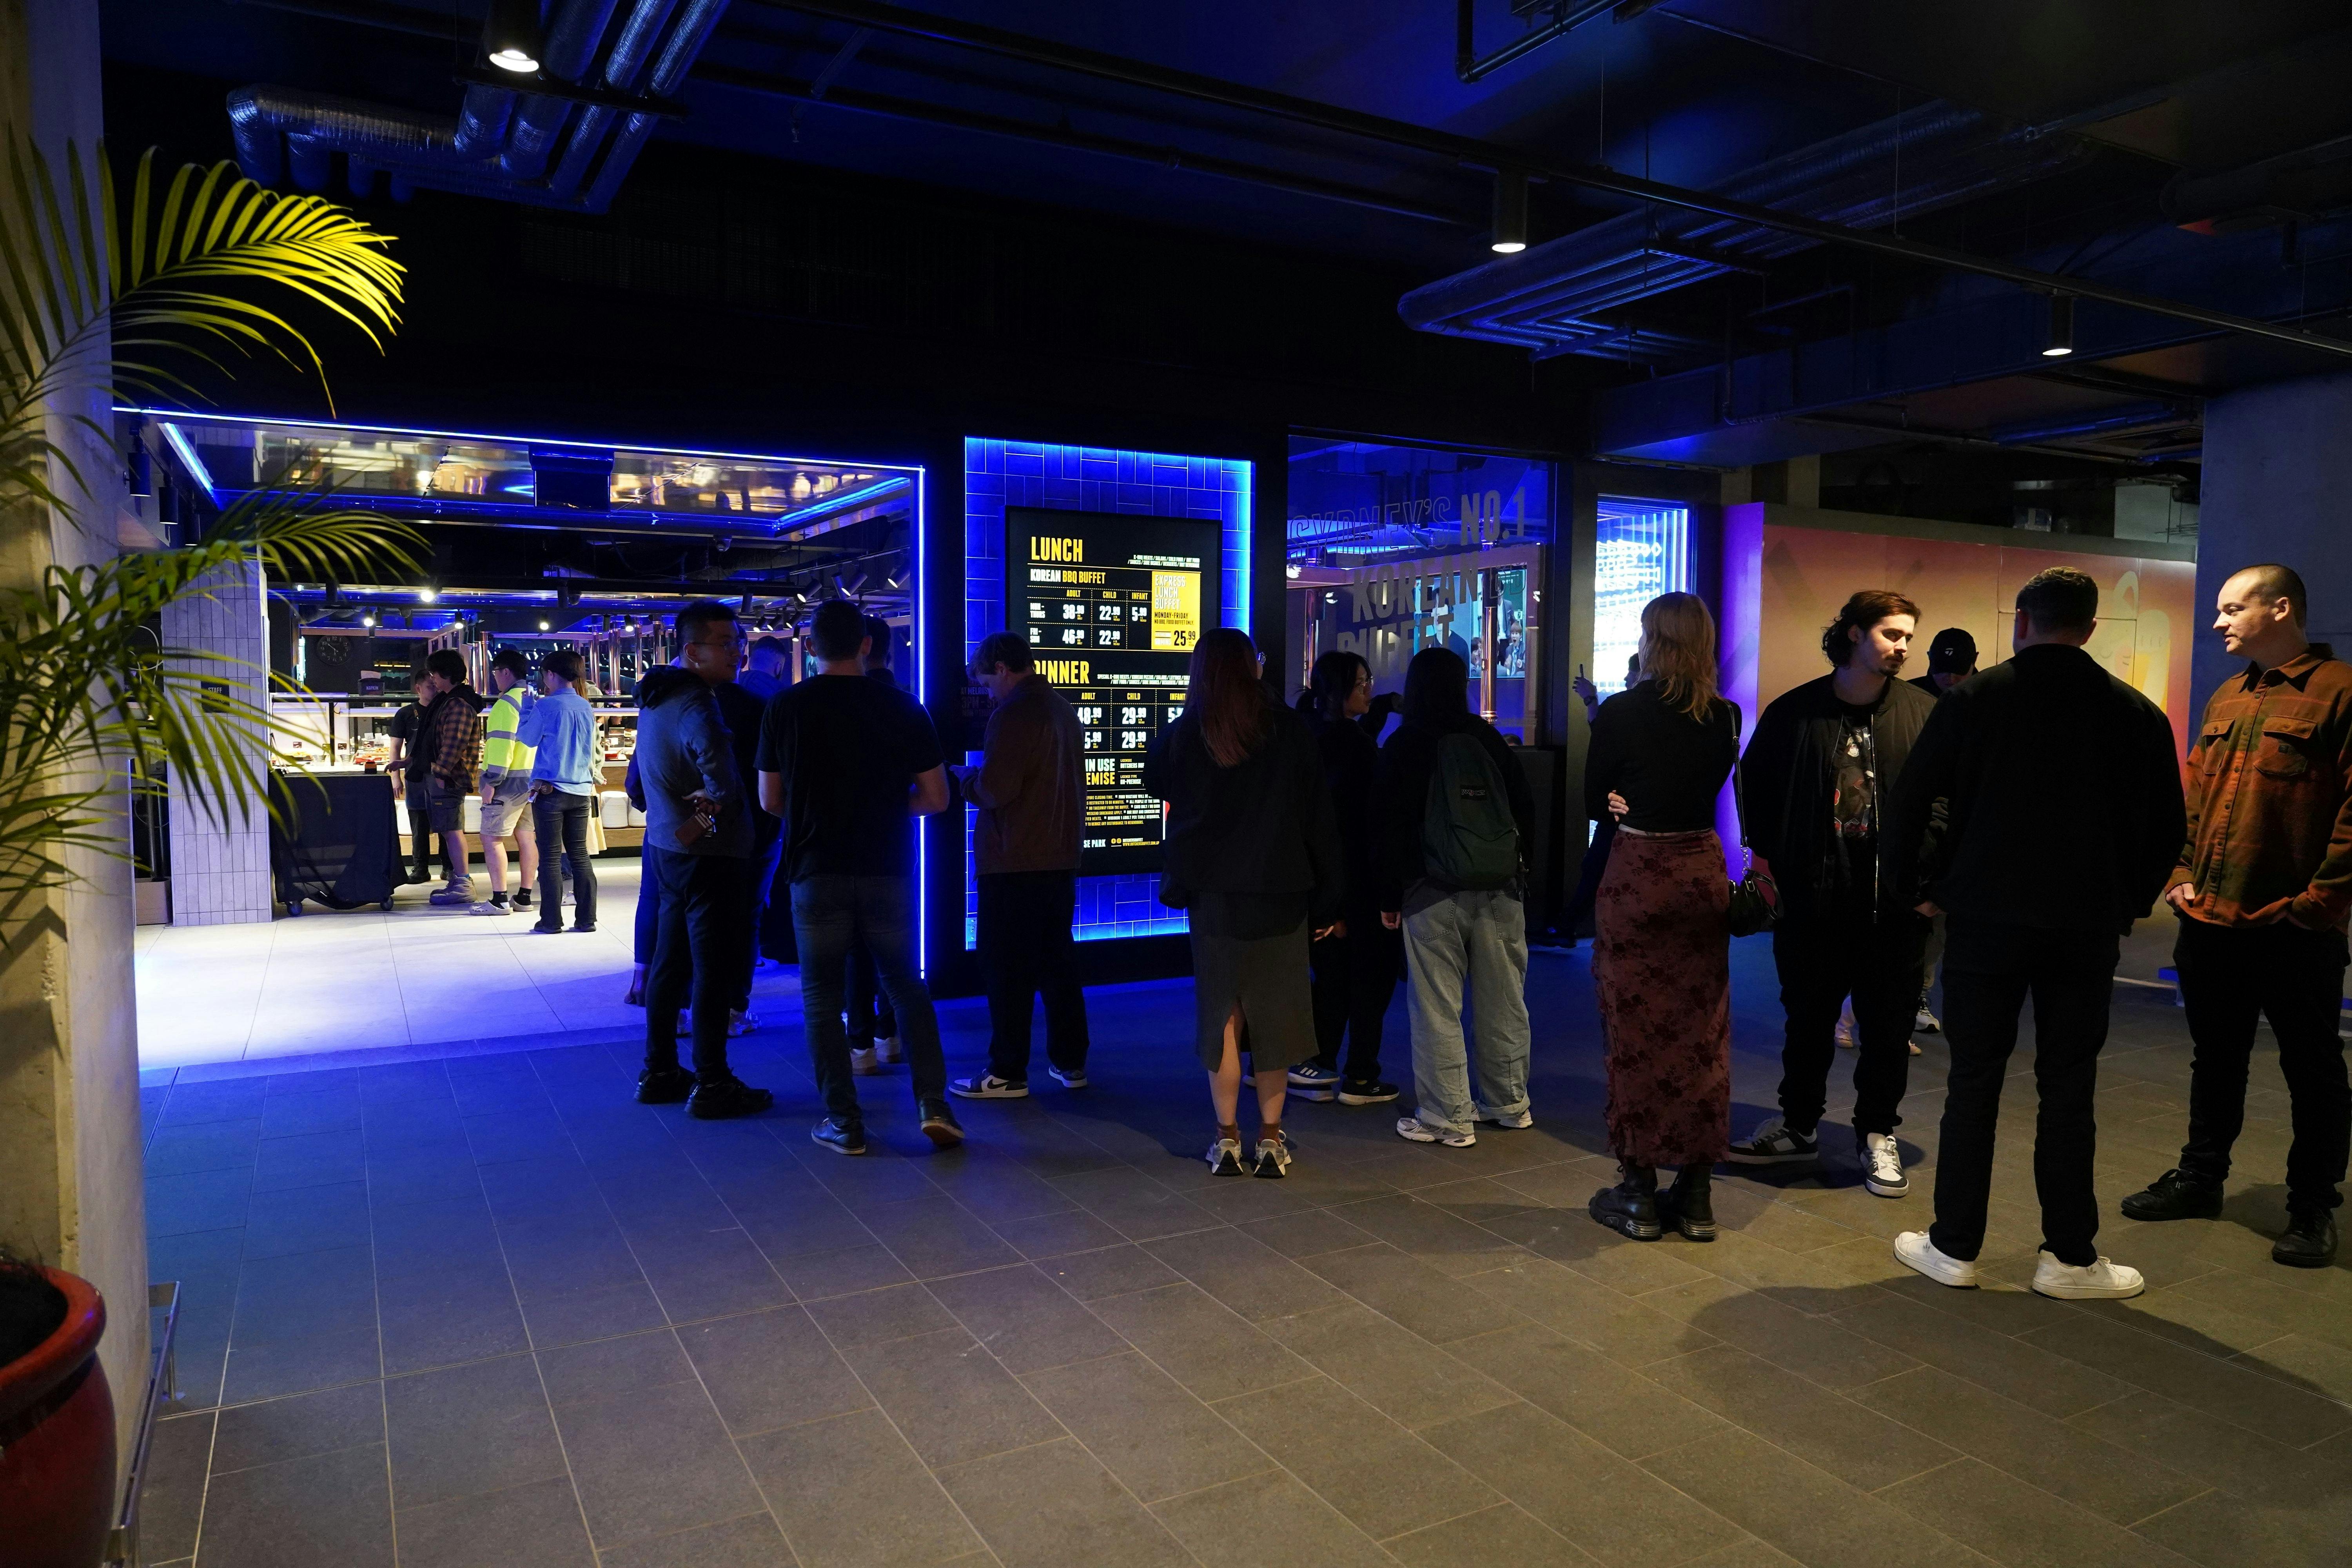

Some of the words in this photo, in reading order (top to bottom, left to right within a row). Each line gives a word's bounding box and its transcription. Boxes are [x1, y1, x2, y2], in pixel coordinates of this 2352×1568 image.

[1290, 496, 1450, 566] SYDNEY'S
[1461, 486, 1525, 546] NO.1
[1031, 537, 1083, 562] LUNCH
[1030, 568, 1061, 582] KOREAN
[1062, 570, 1077, 584] BBQ
[1079, 571, 1105, 584] BUFFET
[1155, 575, 1186, 587] EXPRESS
[1155, 586, 1178, 598] LUNCH
[1353, 551, 1479, 623] KOREAN
[1063, 604, 1084, 619] 38.99
[1155, 598, 1180, 610] BUFFET
[1099, 605, 1120, 620] 22.99
[1132, 606, 1147, 621] 5.99
[1062, 629, 1084, 644] 46.99
[1099, 630, 1120, 645] 22.99
[1174, 630, 1196, 646] 25.99
[1077, 707, 1102, 724] 48.99
[1122, 707, 1146, 724] 29.99
[1084, 732, 1102, 749] 5.99
[1122, 731, 1146, 748] 29.99
[1098, 759, 1115, 771] USE
[1092, 839, 1106, 848] PARK
